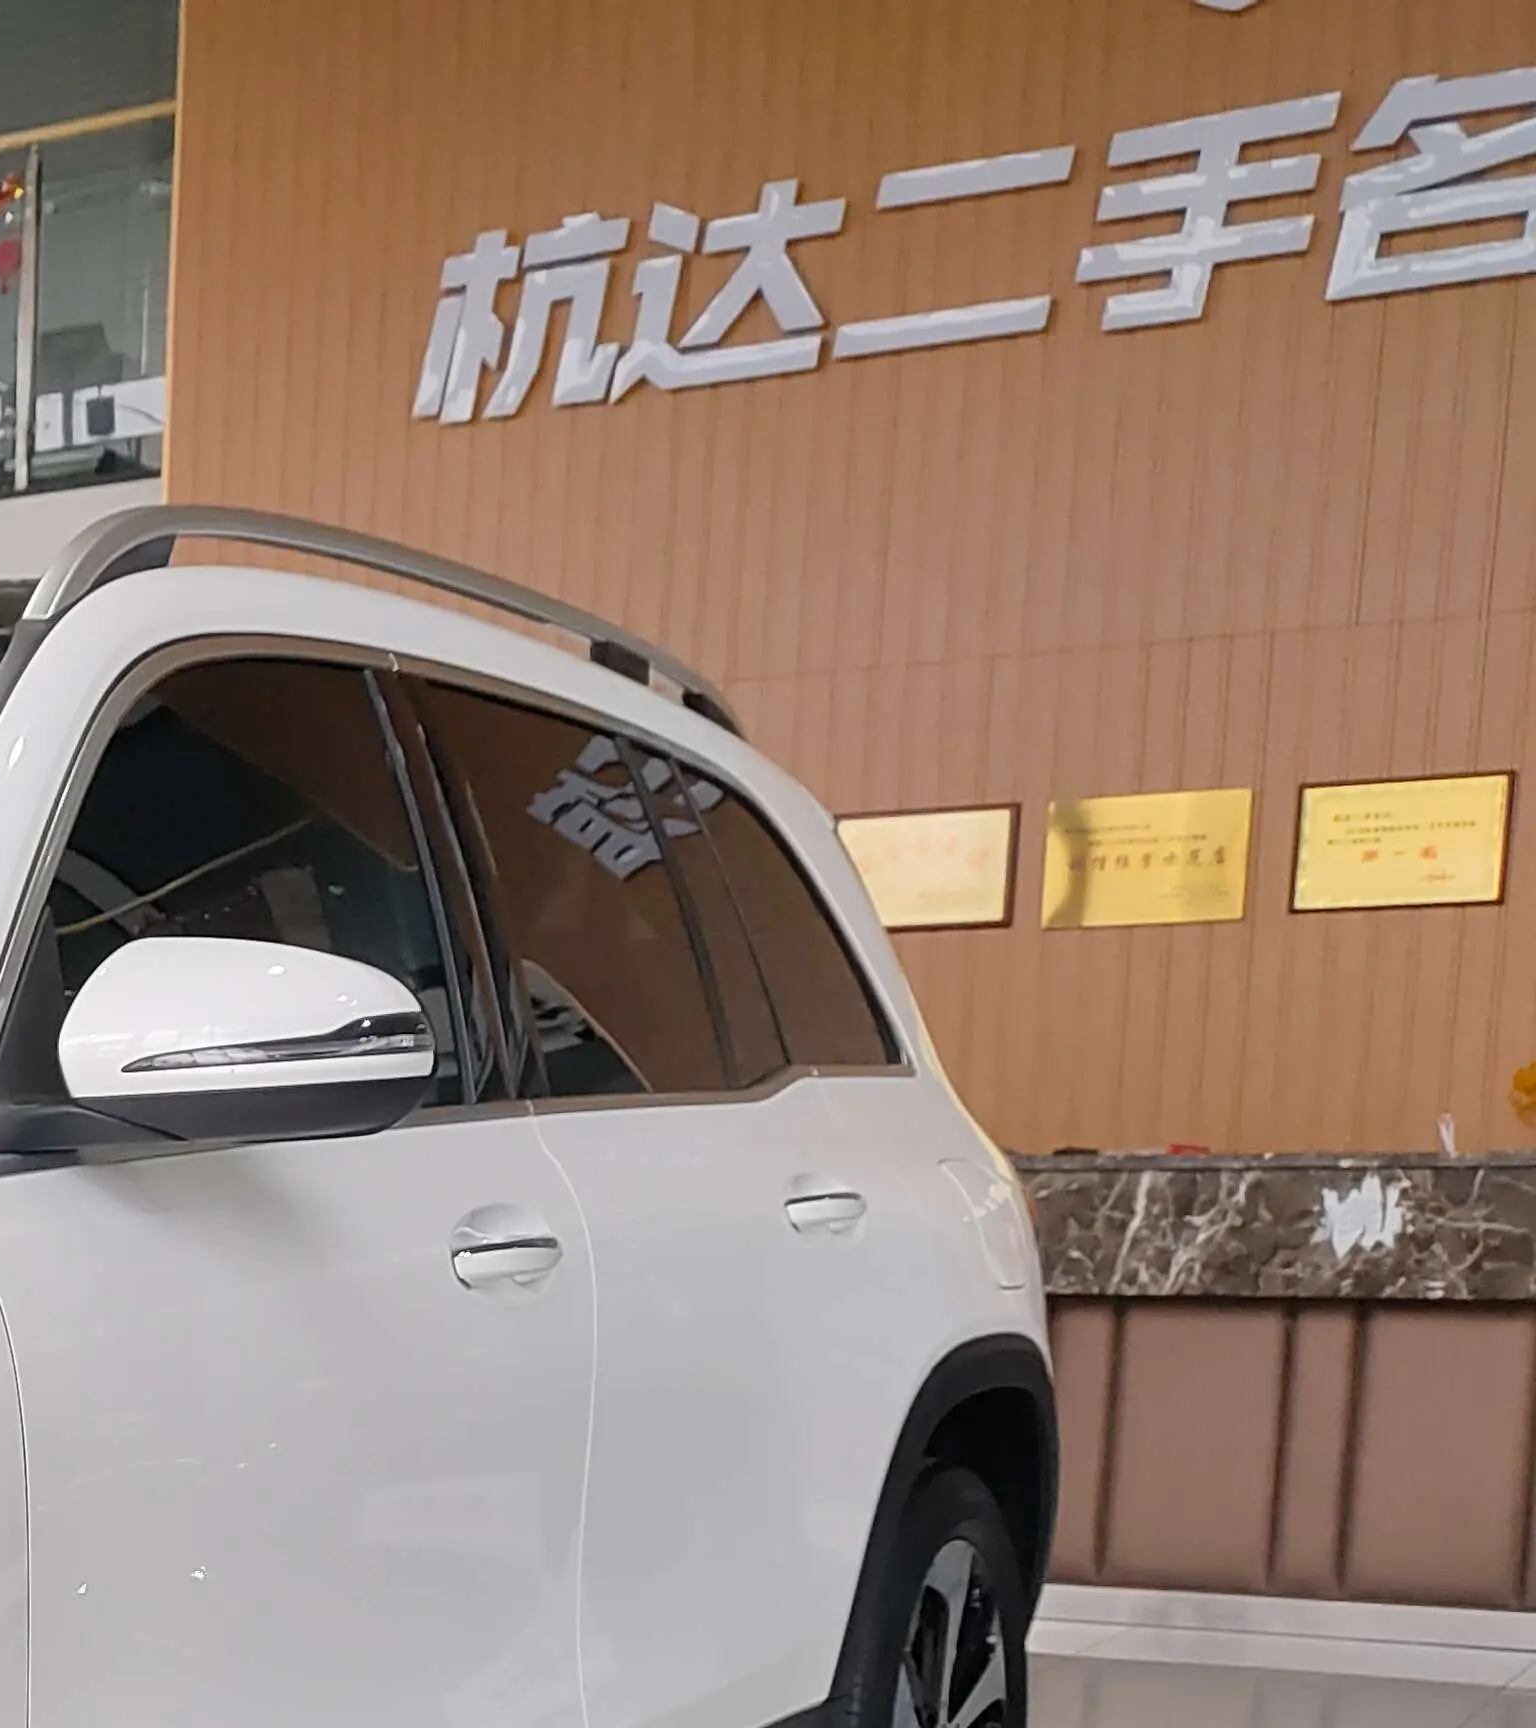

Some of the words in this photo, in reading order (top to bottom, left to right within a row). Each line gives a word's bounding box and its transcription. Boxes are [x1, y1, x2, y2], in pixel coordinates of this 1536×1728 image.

[411, 66, 1536, 425] 杭达二手名
